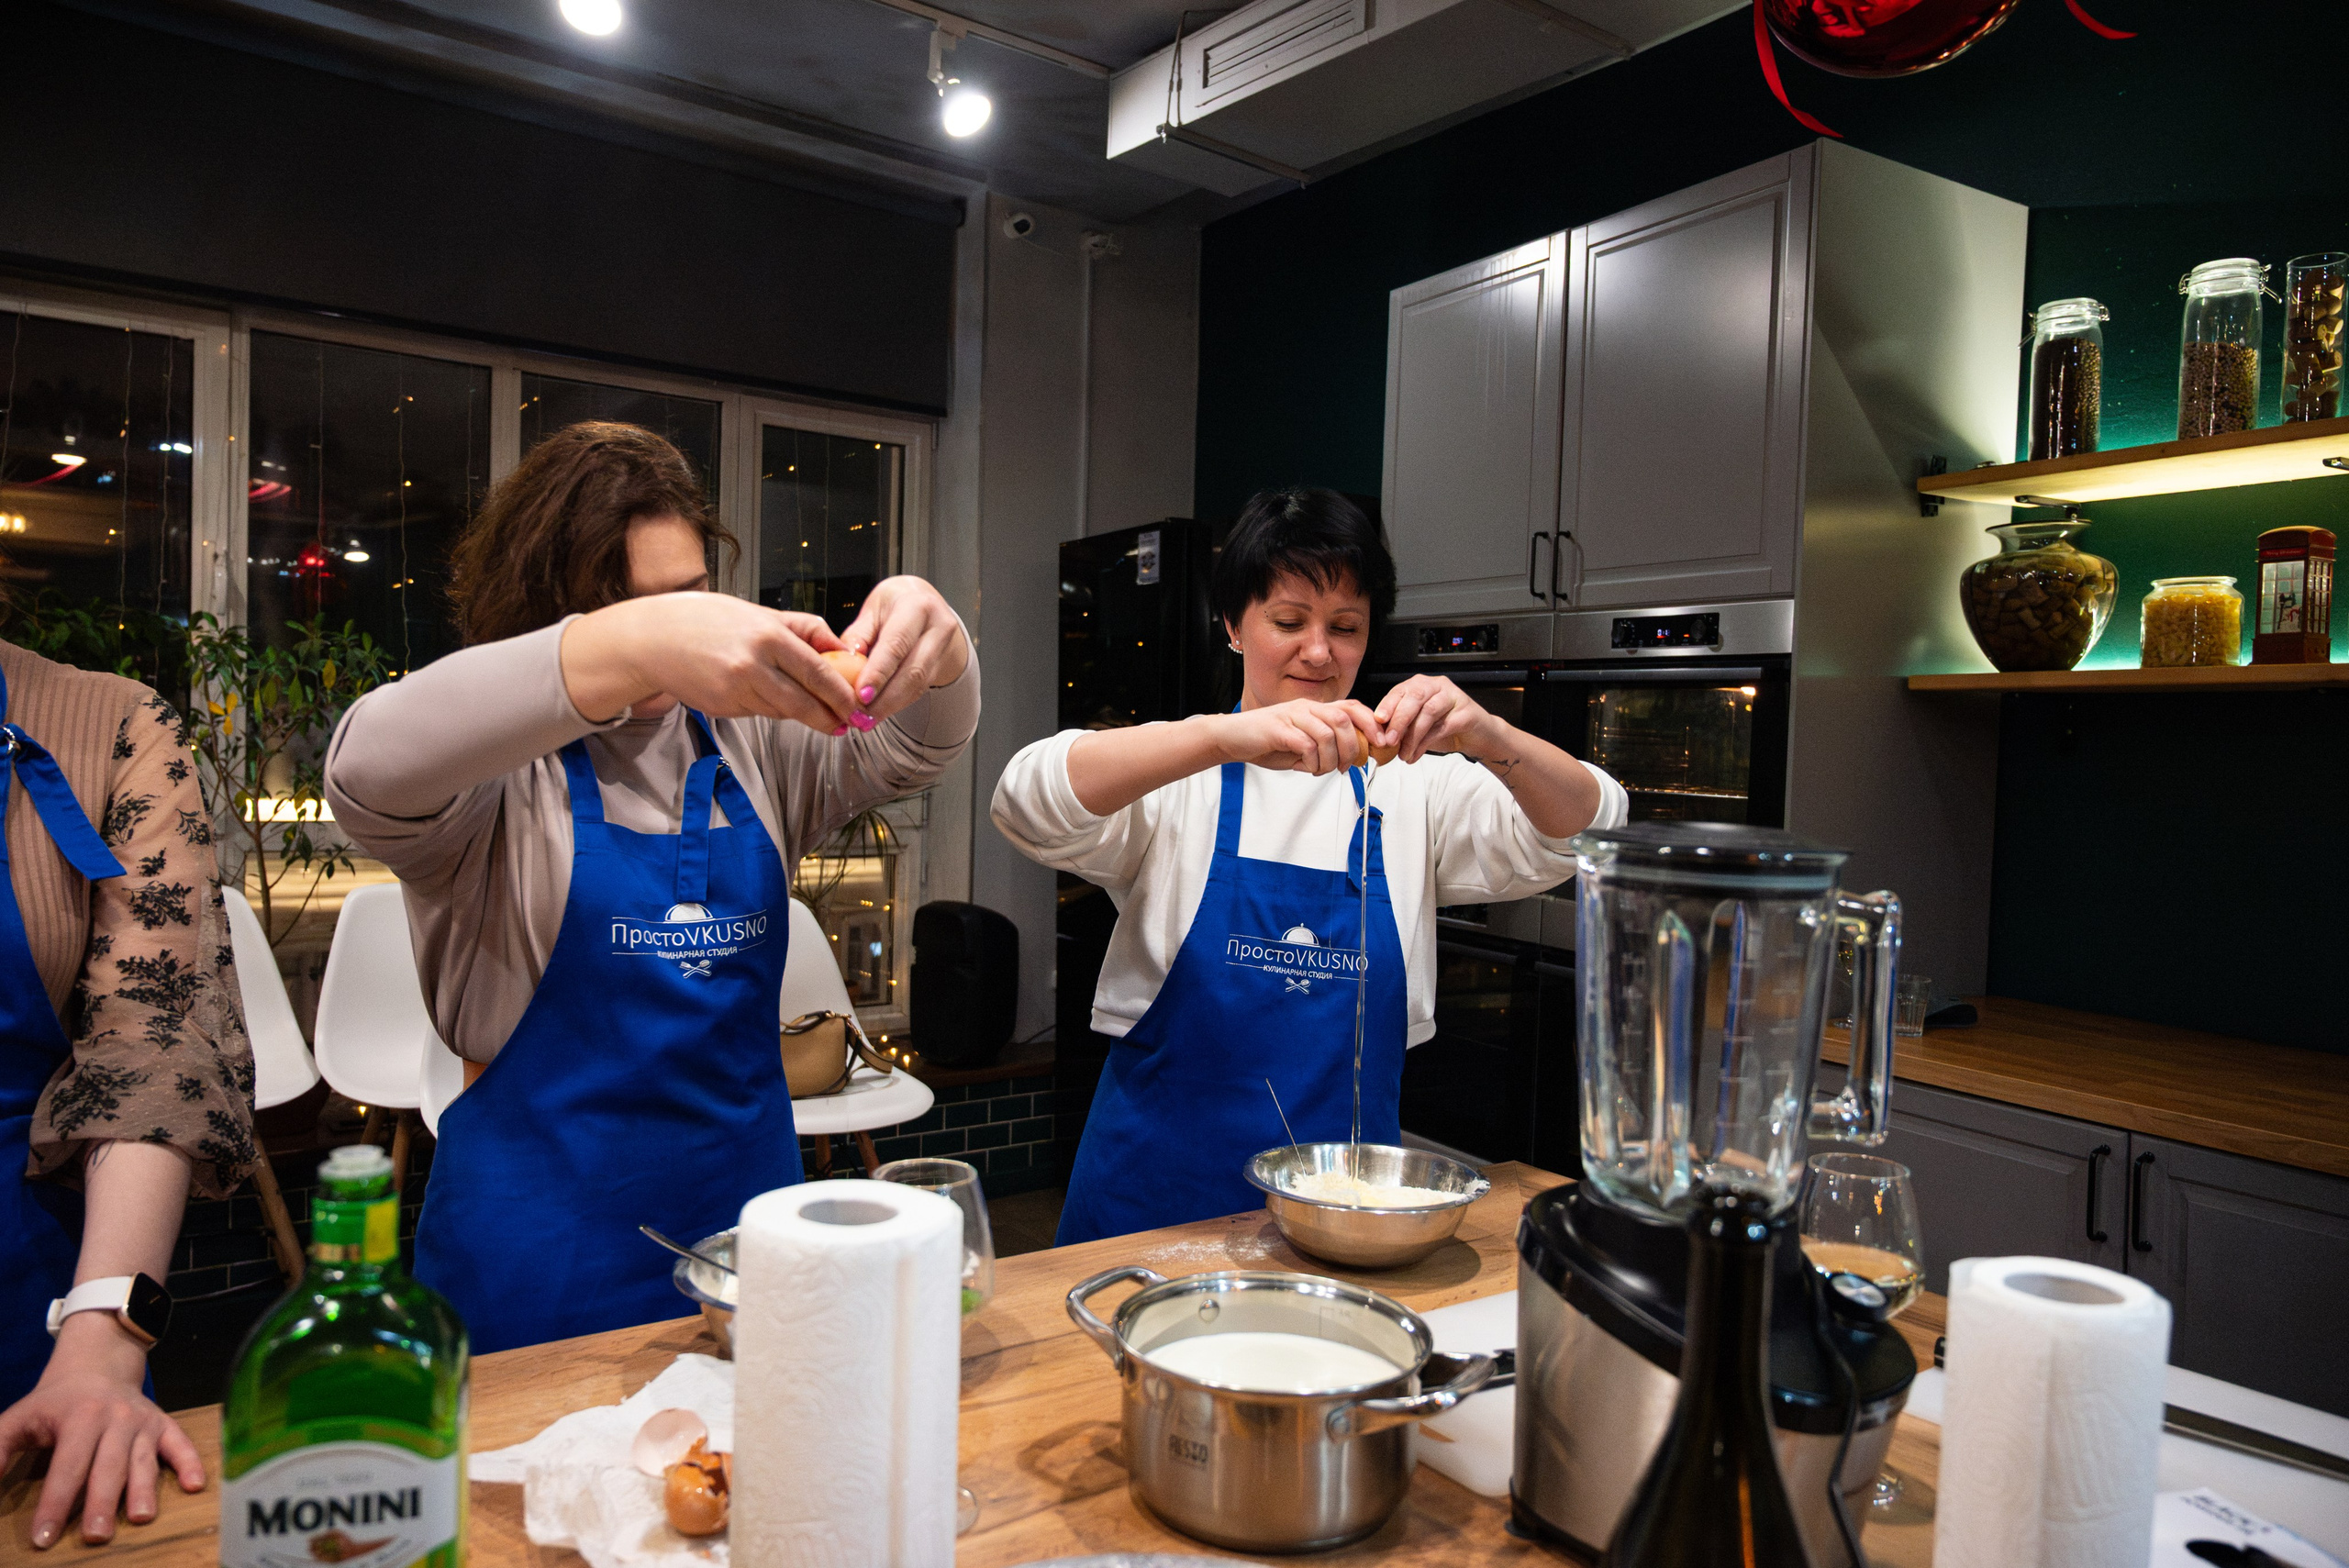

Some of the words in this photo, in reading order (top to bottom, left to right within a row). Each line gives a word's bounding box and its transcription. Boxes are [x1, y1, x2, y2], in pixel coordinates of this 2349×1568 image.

[611, 916, 767, 949] ПростоVKUSNO
[707, 946, 738, 957] СТУДИЯ
[1226, 939, 1369, 972] ПростоVKUSNO
[1263, 964, 1307, 977] КУЛИНАРНАЯ
[1308, 971, 1333, 980] СТУДИЯ
[246, 1485, 422, 1538] MONINI
